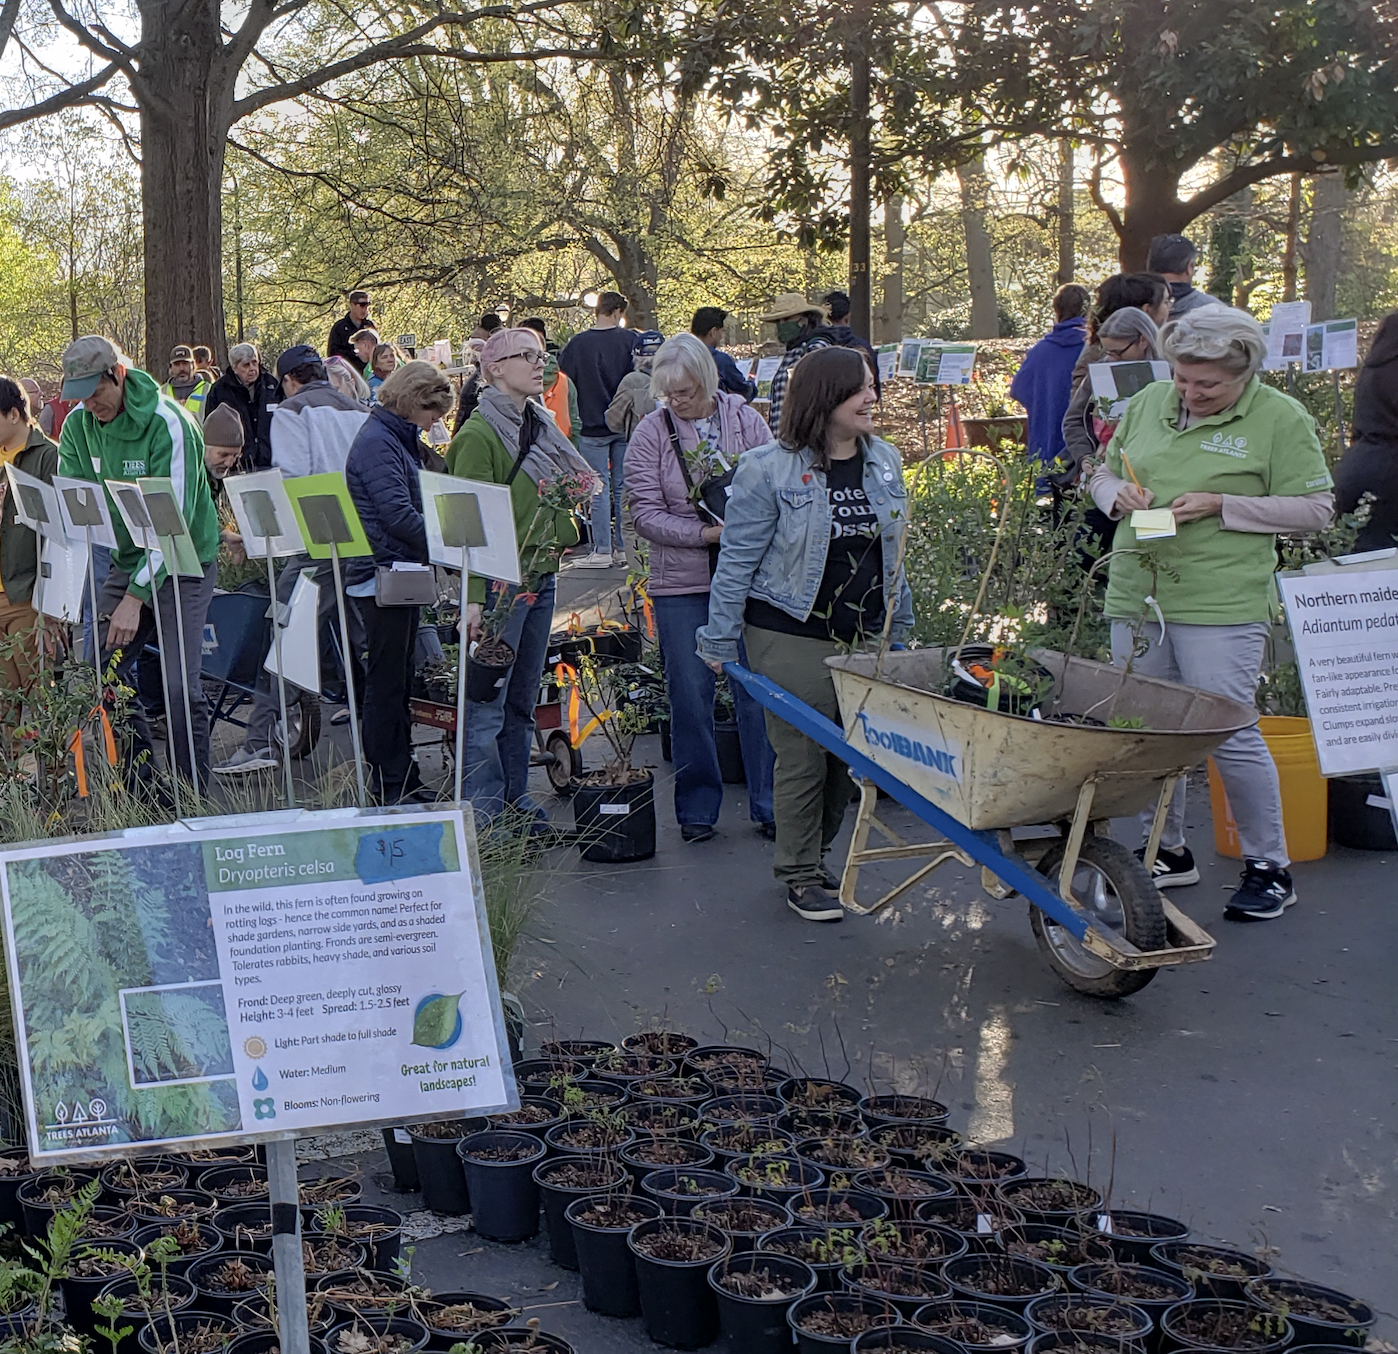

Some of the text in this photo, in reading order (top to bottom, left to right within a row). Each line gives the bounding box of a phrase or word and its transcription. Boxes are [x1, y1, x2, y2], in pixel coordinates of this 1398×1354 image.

[399, 336, 413, 345] EAST
[1294, 591, 1358, 609] Northern
[1302, 618, 1363, 635] Adiantum
[1309, 658, 1317, 668] A
[1316, 658, 1335, 668] very
[1335, 652, 1373, 665] beautiful
[1372, 651, 1391, 661] fern
[1311, 671, 1344, 684] fan-like
[1343, 668, 1392, 681] appearance
[1314, 682, 1398, 699] Fairly adaptable. Pre
[1318, 702, 1363, 716] consistent
[1322, 720, 1355, 731] Clumps
[1354, 714, 1385, 728] expand
[1325, 735, 1343, 747] and
[1343, 736, 1358, 745] are
[1358, 732, 1382, 744] easily
[214, 843, 286, 864] Log Fern
[375, 839, 404, 867] $15
[218, 859, 335, 885] Dryopteris celsa
[223, 889, 424, 916] In the wild, this fern is often found growing on
[225, 917, 258, 929] rotting
[258, 915, 278, 928] logs
[284, 913, 313, 924] hence
[313, 910, 330, 921] the
[330, 908, 371, 919] common
[371, 903, 398, 916] name!
[399, 901, 429, 914] Perfect
[429, 900, 443, 912] for
[227, 913, 446, 943] shade gardens, narrow side yards, and as a shaded
[229, 930, 439, 959] foundation planting. Fronds are semi-evergreen.
[231, 941, 437, 972] Tolerates rabbits, heavy shade, and various soil
[234, 975, 262, 987] types.
[237, 984, 402, 1009] Frond: Deep green, deeply cut, glossy
[239, 996, 410, 1023] Height: 3-4 feet Spread: 1.5-2.5 feet
[274, 1026, 397, 1050] Light: Part shade to full shade
[278, 1064, 347, 1080] Water: Medium
[401, 1055, 490, 1076] Great for natural
[420, 1074, 477, 1093] landscapes!
[283, 1093, 381, 1111] Blooms: Non-flowering
[46, 1124, 119, 1140] TREES ATLANTA
